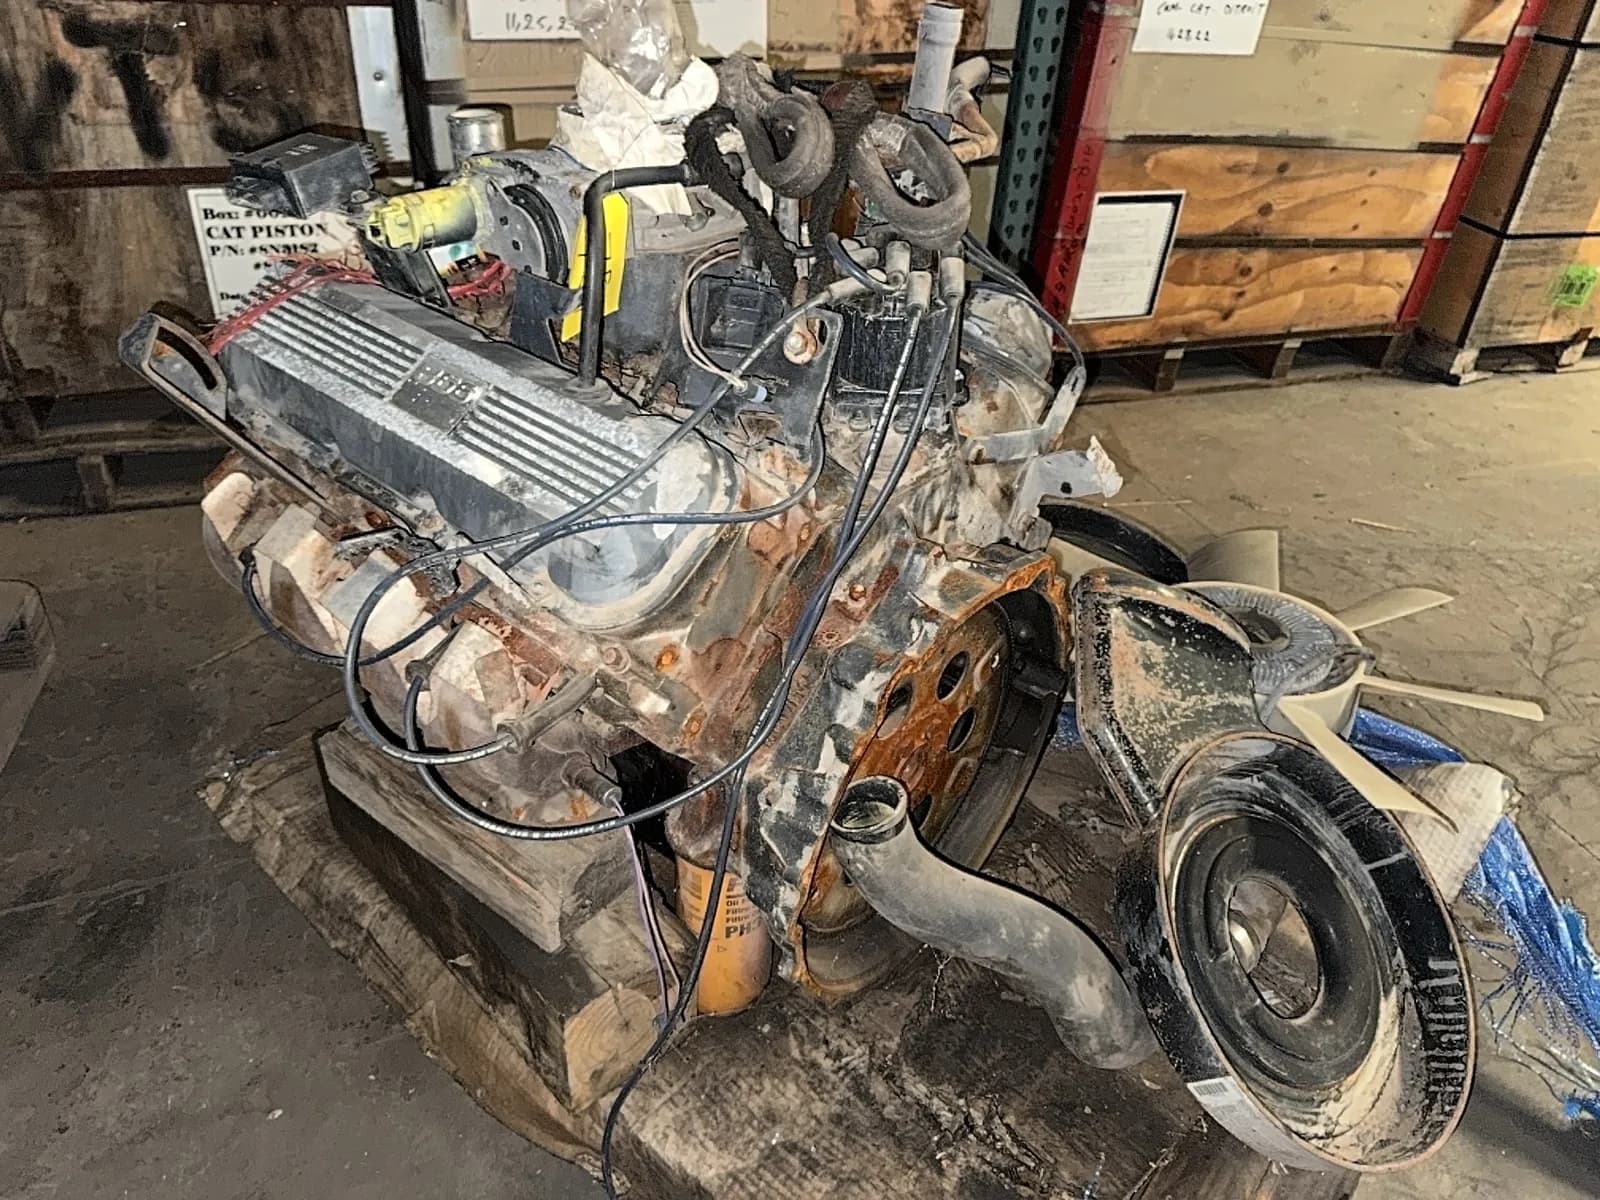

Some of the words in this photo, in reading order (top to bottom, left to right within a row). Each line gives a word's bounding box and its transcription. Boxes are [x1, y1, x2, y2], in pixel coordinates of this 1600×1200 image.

[203, 208, 239, 220] Box:
[206, 226, 245, 239] CAT
[251, 223, 327, 239] PISTON
[210, 245, 244, 256] P/N:
